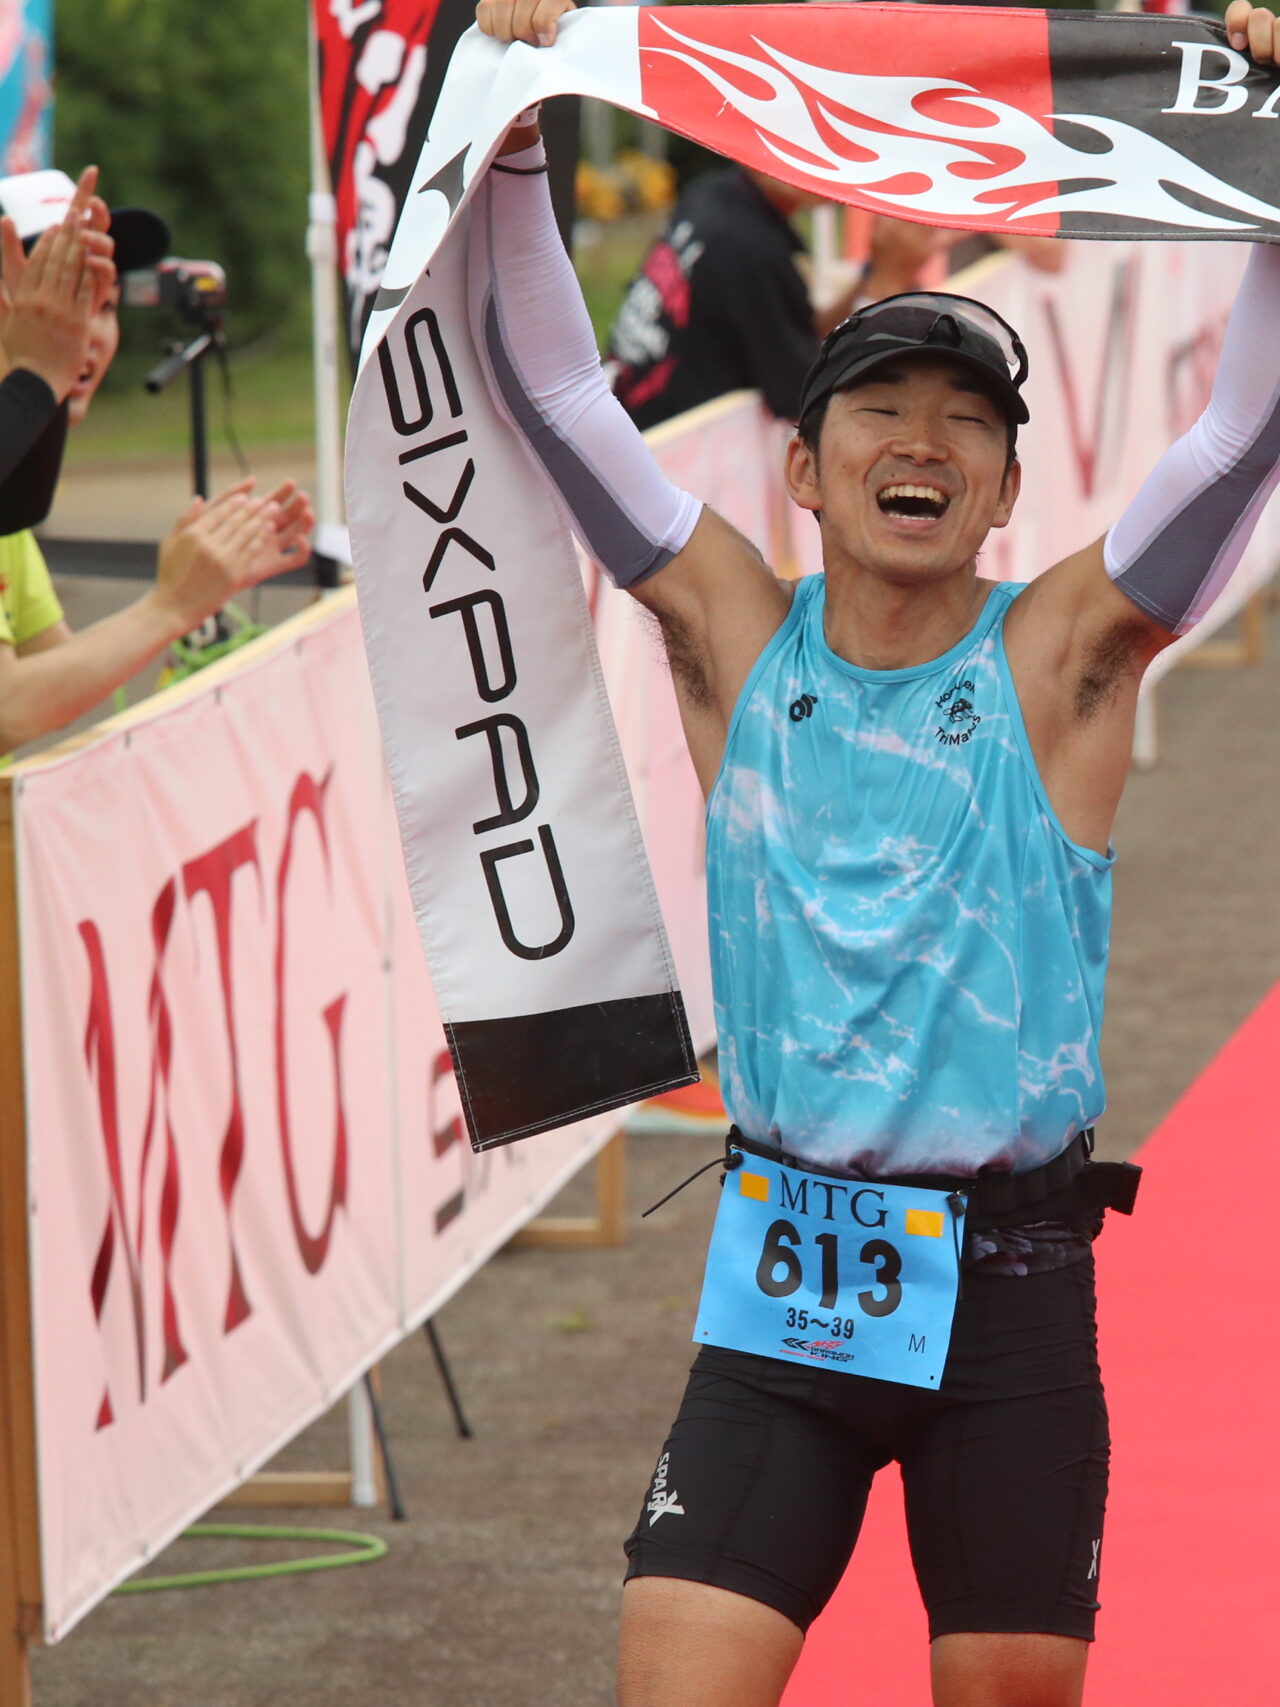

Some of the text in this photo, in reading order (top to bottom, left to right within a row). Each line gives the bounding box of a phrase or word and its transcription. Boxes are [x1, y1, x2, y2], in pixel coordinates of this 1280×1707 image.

[378, 307, 576, 961] SIXPAD
[77, 763, 348, 1432] MTG
[779, 1171, 889, 1229] MTG
[756, 1219, 903, 1318] 613
[908, 1333, 926, 1354] M
